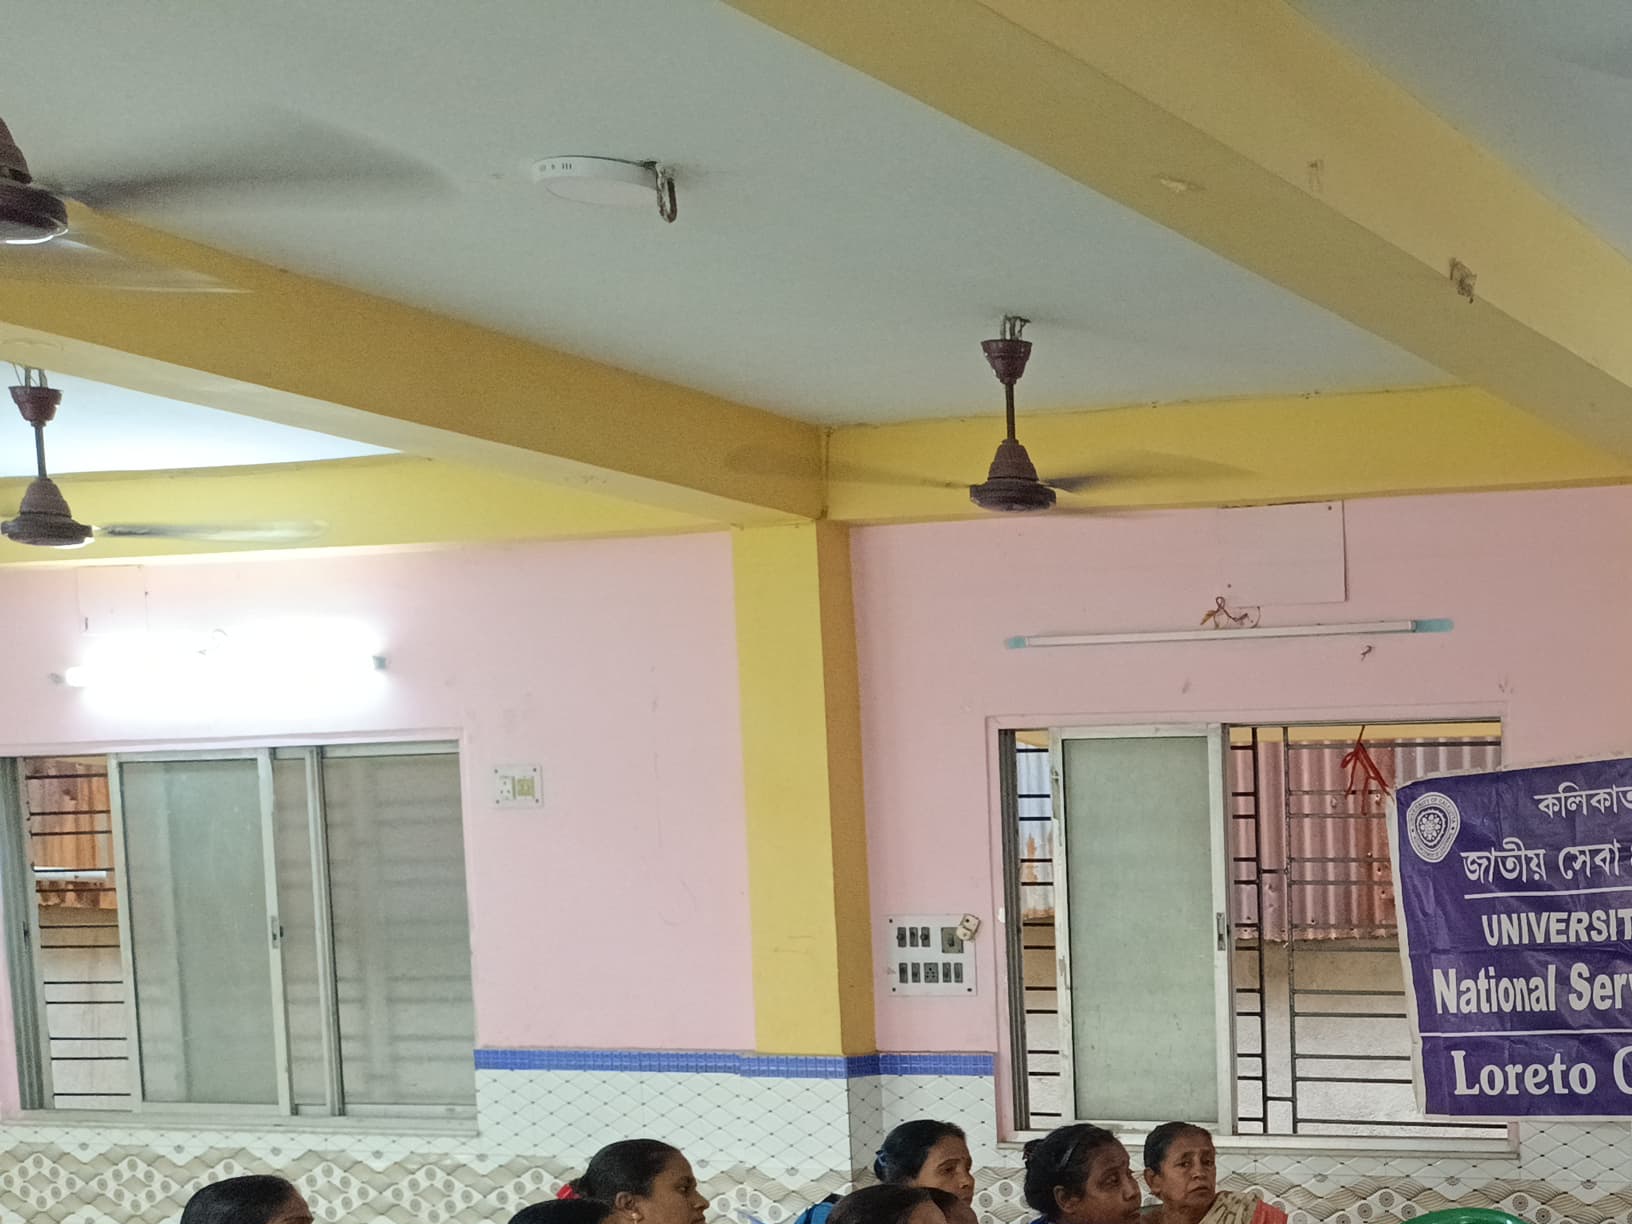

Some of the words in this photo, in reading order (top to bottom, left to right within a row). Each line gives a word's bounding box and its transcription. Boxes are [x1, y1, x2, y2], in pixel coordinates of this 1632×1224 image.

[1459, 836, 1548, 884] জাতীয়
[1558, 838, 1622, 880] সেবা
[1432, 963, 1557, 1014] National
[1451, 1050, 1597, 1096] Loreto
